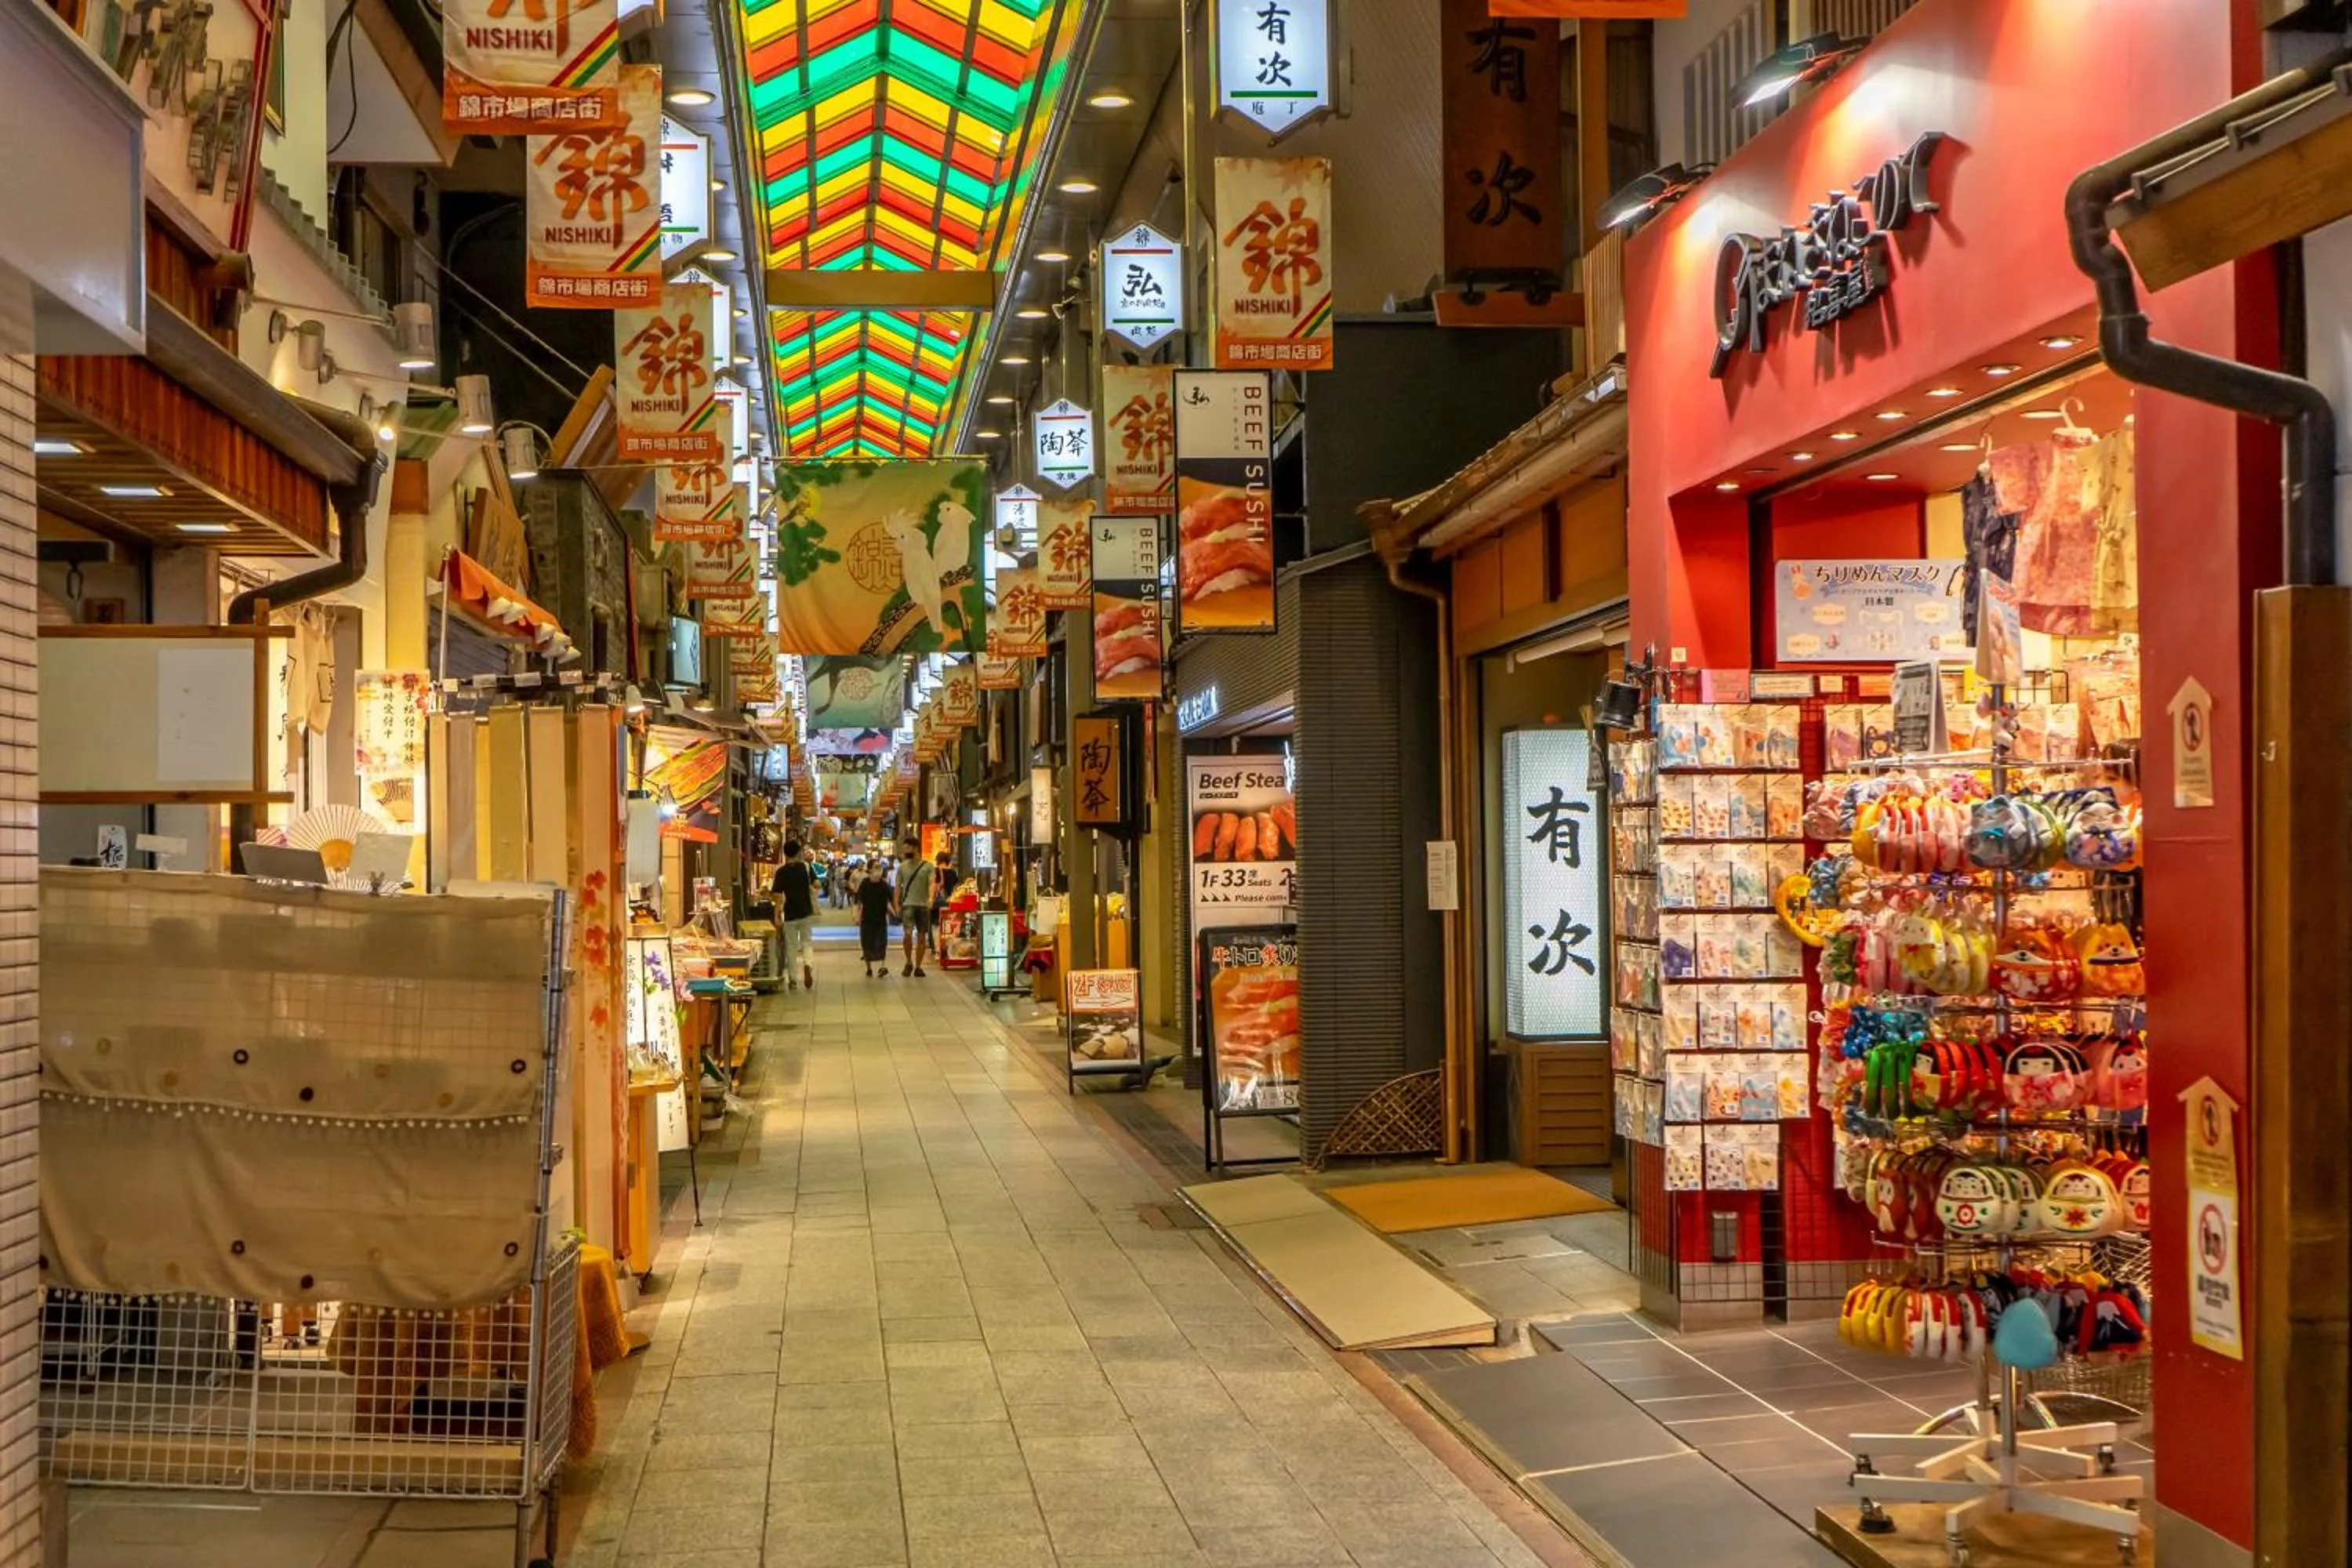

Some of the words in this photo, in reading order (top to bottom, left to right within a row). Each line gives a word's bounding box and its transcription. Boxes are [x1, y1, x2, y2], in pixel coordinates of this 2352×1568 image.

[466, 27, 554, 51] NISHIKI
[1255, 1, 1292, 87] 有次
[458, 95, 603, 119] 錦市場商店街
[1465, 17, 1543, 227] 有次
[544, 227, 613, 245] NISHIKI
[1223, 197, 1323, 318] 錦
[537, 277, 648, 298] 錦市場商店街
[1122, 263, 1163, 297] 弘
[1234, 299, 1292, 314] NISHIKI
[622, 312, 707, 416] 錦
[1228, 343, 1323, 361] 錦市場商店街
[630, 399, 681, 412] NISHIKI
[1243, 386, 1264, 451] BEEF
[1109, 391, 1174, 477] 錦
[1116, 463, 1158, 474] NISHIKI
[665, 493, 705, 505] NISHIKI
[1246, 464, 1265, 544] SUSHI
[1041, 521, 1091, 586] 錦
[1139, 527, 1154, 575] BEEF
[1814, 564, 1941, 583] ちりめんマスク
[1141, 583, 1156, 640] SUSHI
[1199, 771, 1243, 789] Beef
[1244, 771, 1286, 788] Stea
[1221, 868, 1247, 887] 33
[1247, 878, 1272, 887] Seats
[1212, 943, 1298, 970] 牛トロ炙り
